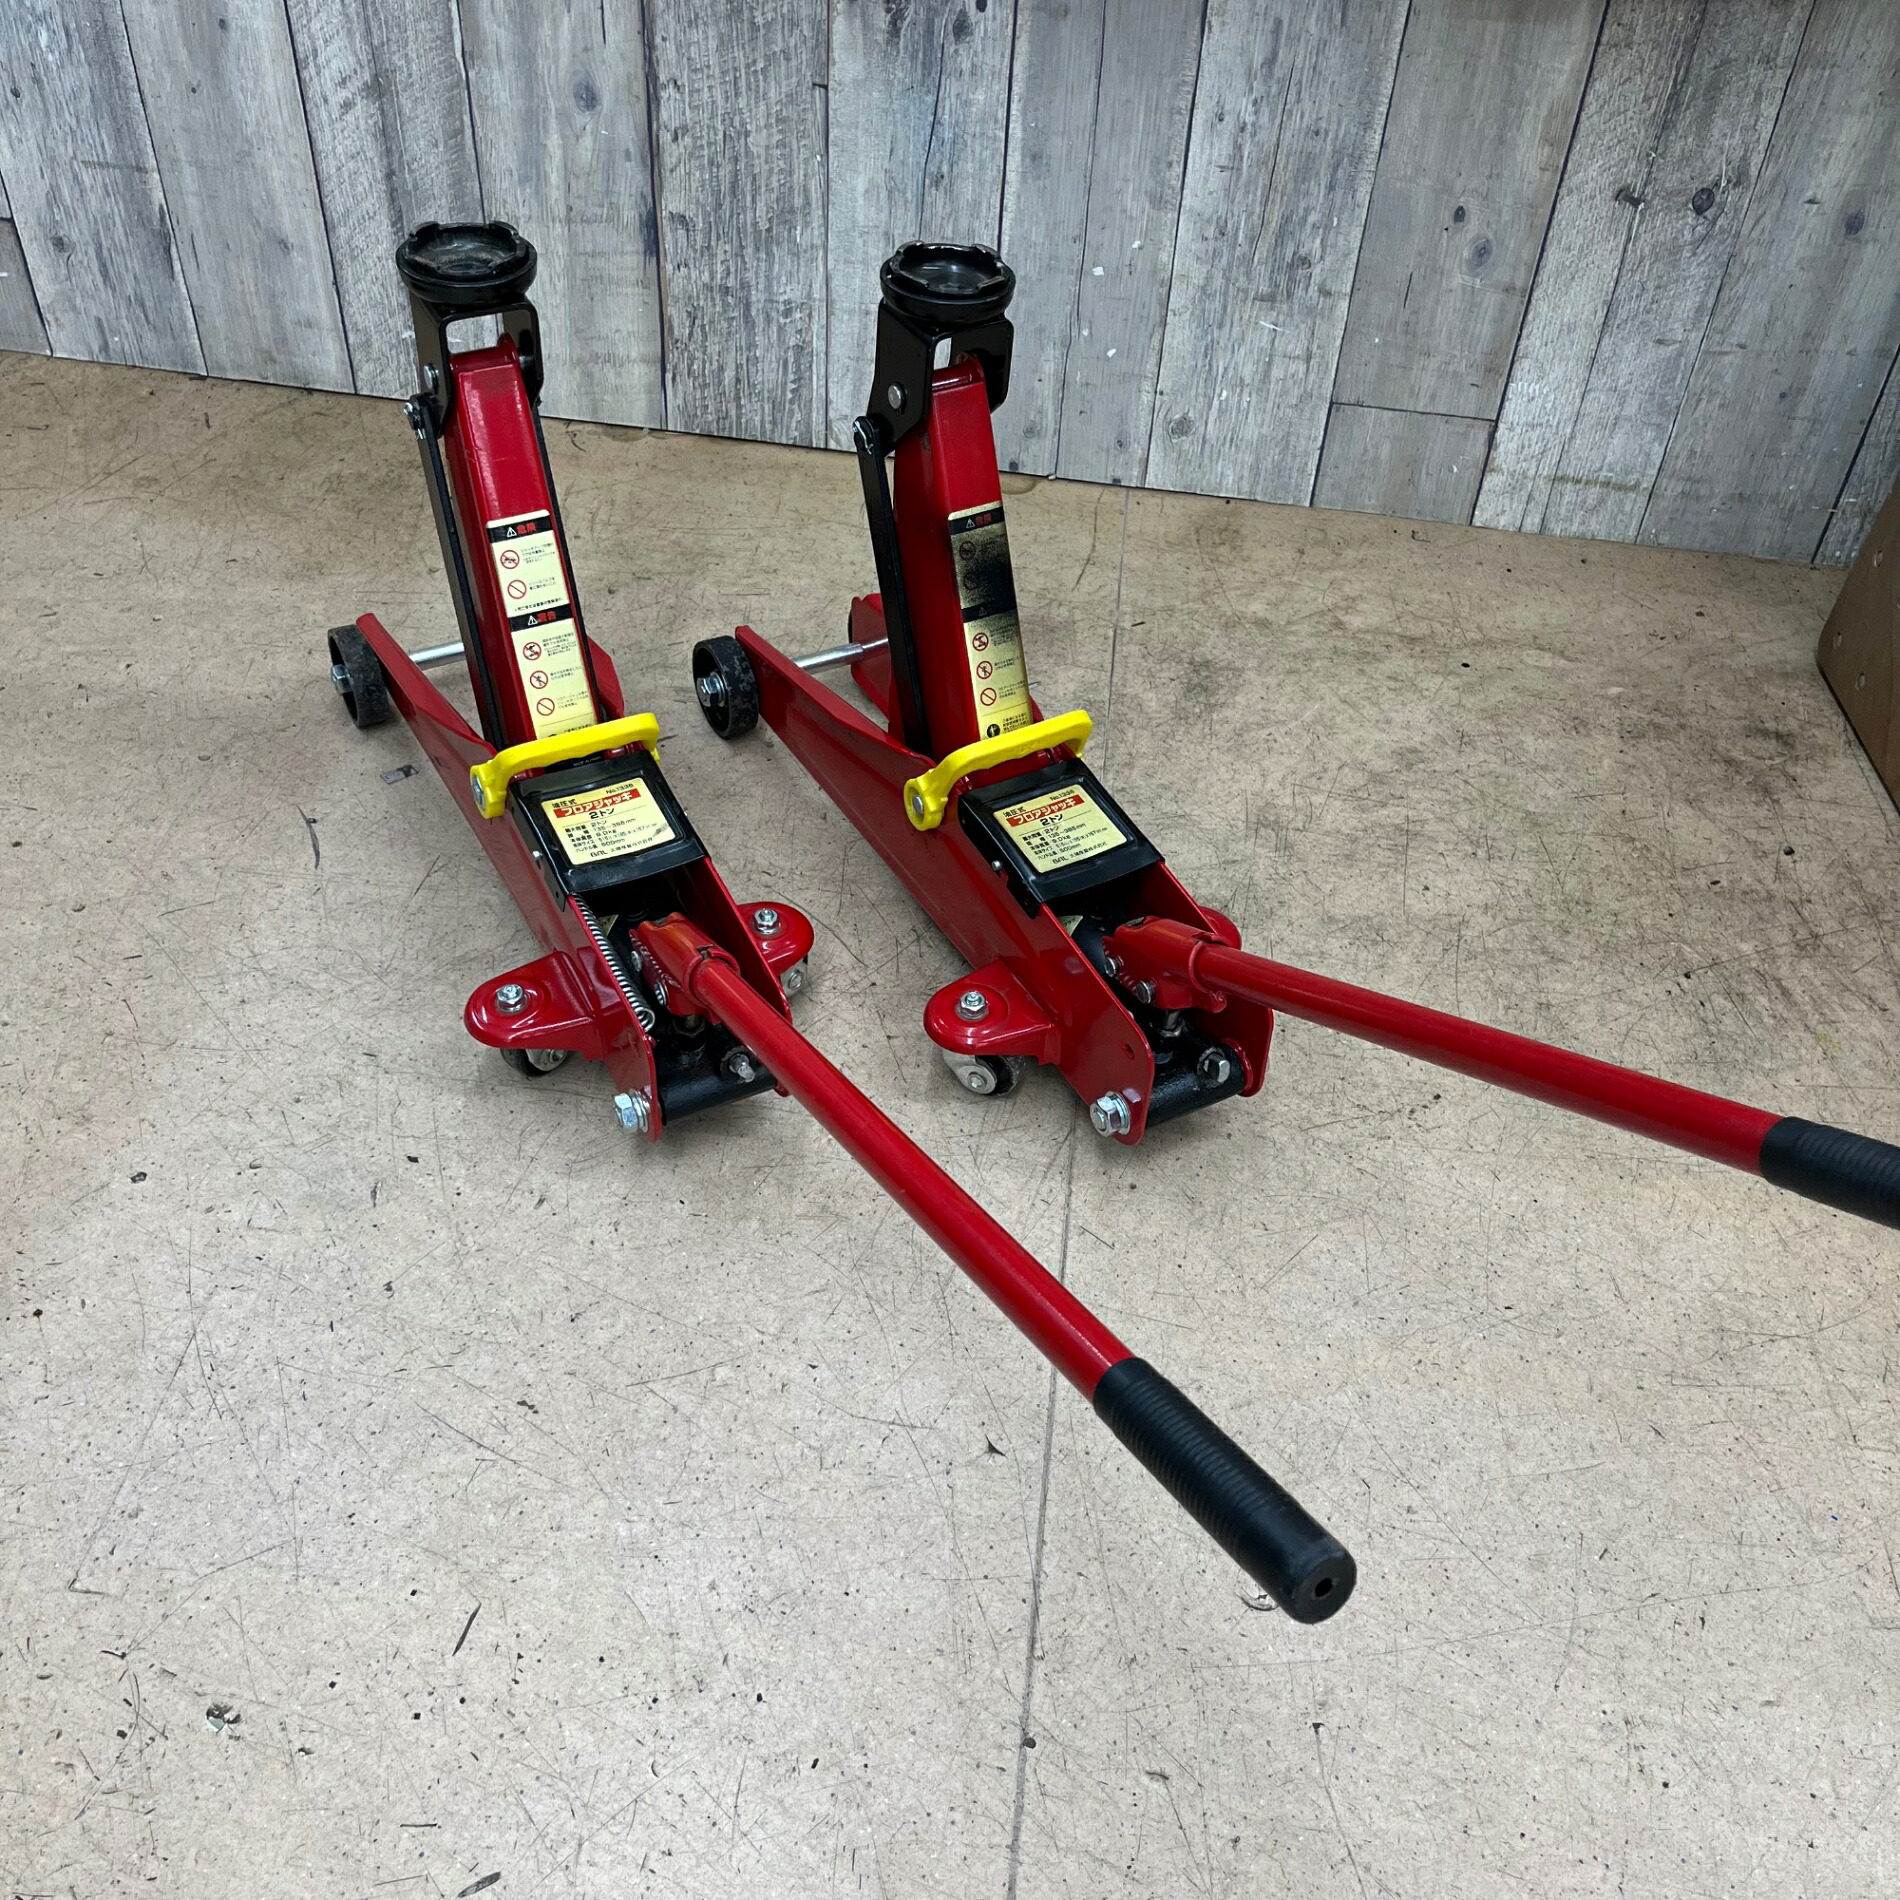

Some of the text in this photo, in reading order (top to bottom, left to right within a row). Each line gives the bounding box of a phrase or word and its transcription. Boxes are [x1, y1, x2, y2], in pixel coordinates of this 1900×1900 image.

[552, 799, 577, 808] 油圧式
[562, 792, 632, 816] フロアジャッキ
[589, 808, 614, 819] 2トン
[1003, 807, 1026, 817] 油圧式
[1014, 798, 1076, 823] フロアジャッキ
[1040, 814, 1062, 825] 2トン
